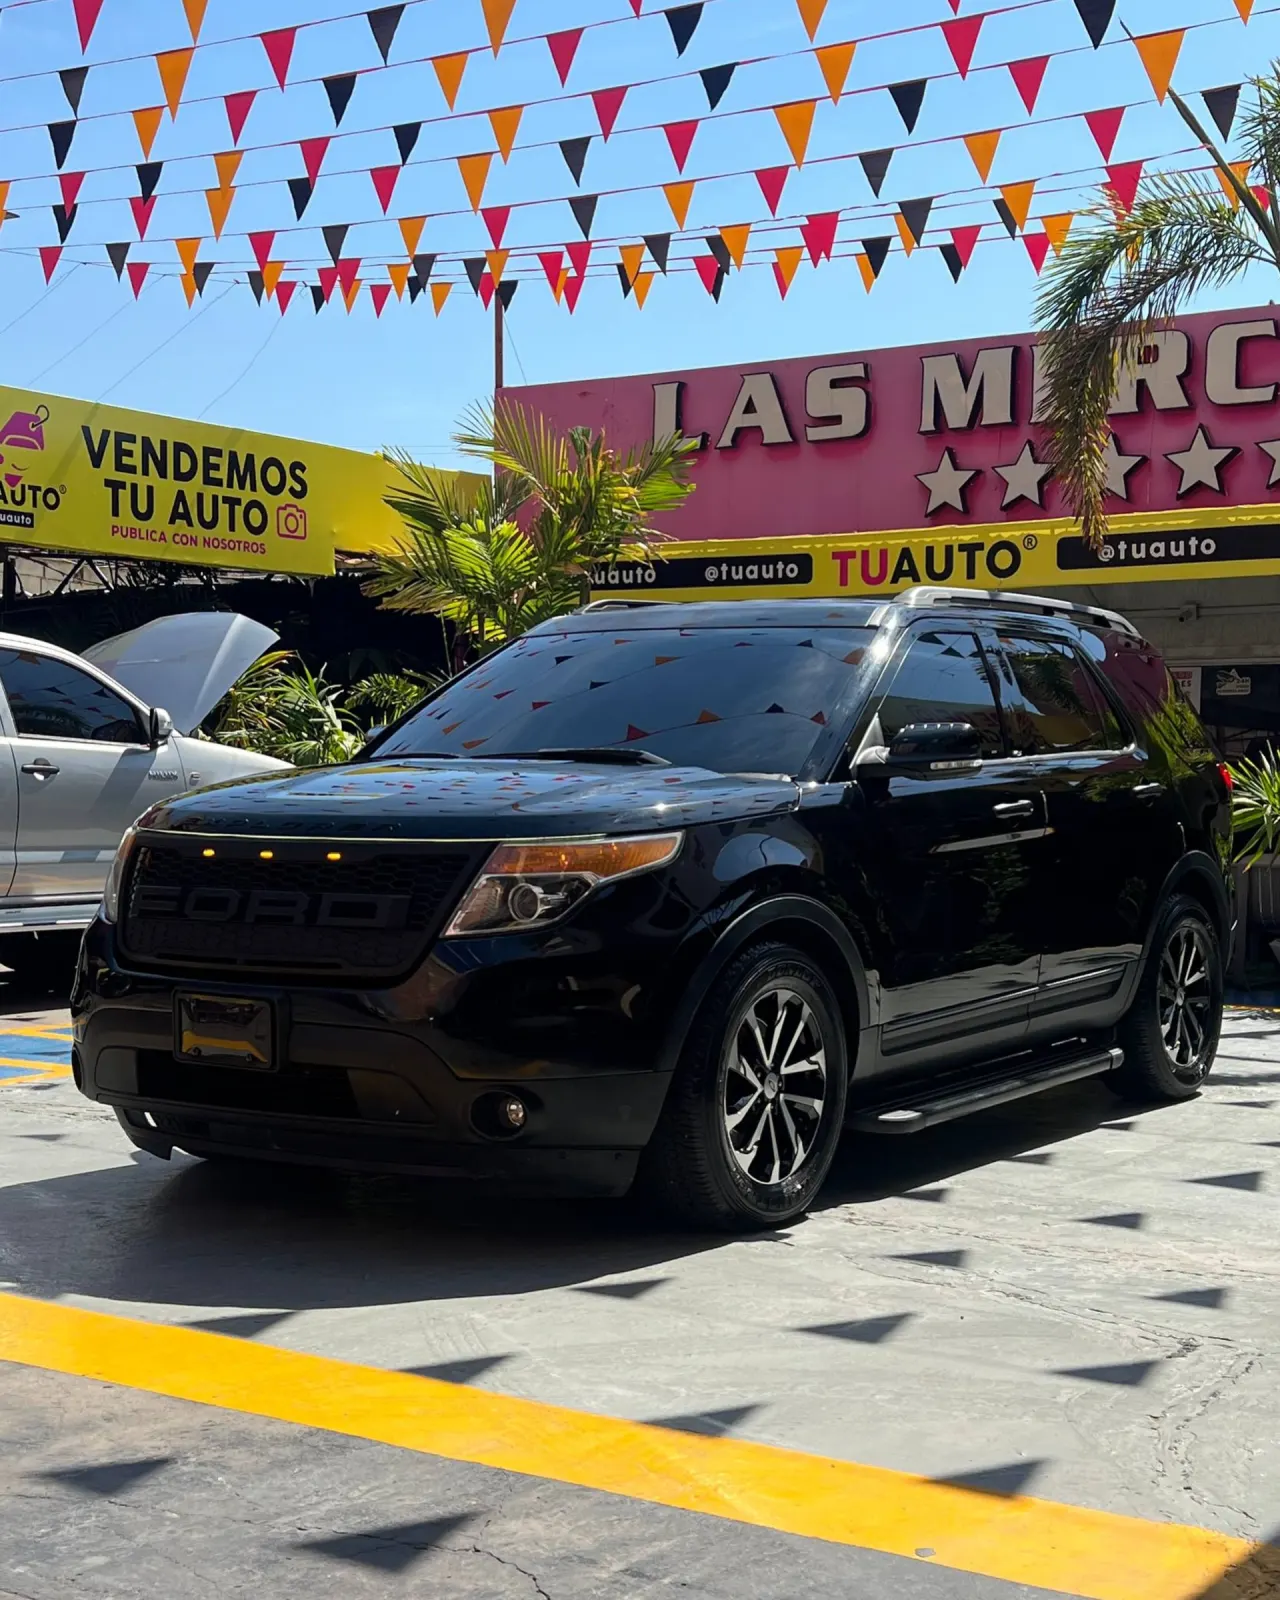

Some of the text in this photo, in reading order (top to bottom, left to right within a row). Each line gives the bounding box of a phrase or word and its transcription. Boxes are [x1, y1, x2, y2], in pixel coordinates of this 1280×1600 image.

[649, 361, 871, 453] LAS
[81, 424, 308, 500] VENDEMOS
[103, 477, 269, 536] TU AUTO
[111, 524, 266, 555] PUBLICA CON NOSOTROS
[1096, 536, 1217, 563] @tuauto
[587, 566, 657, 585] uauto
[704, 560, 799, 582] @tuauto
[128, 884, 413, 929] FORD
